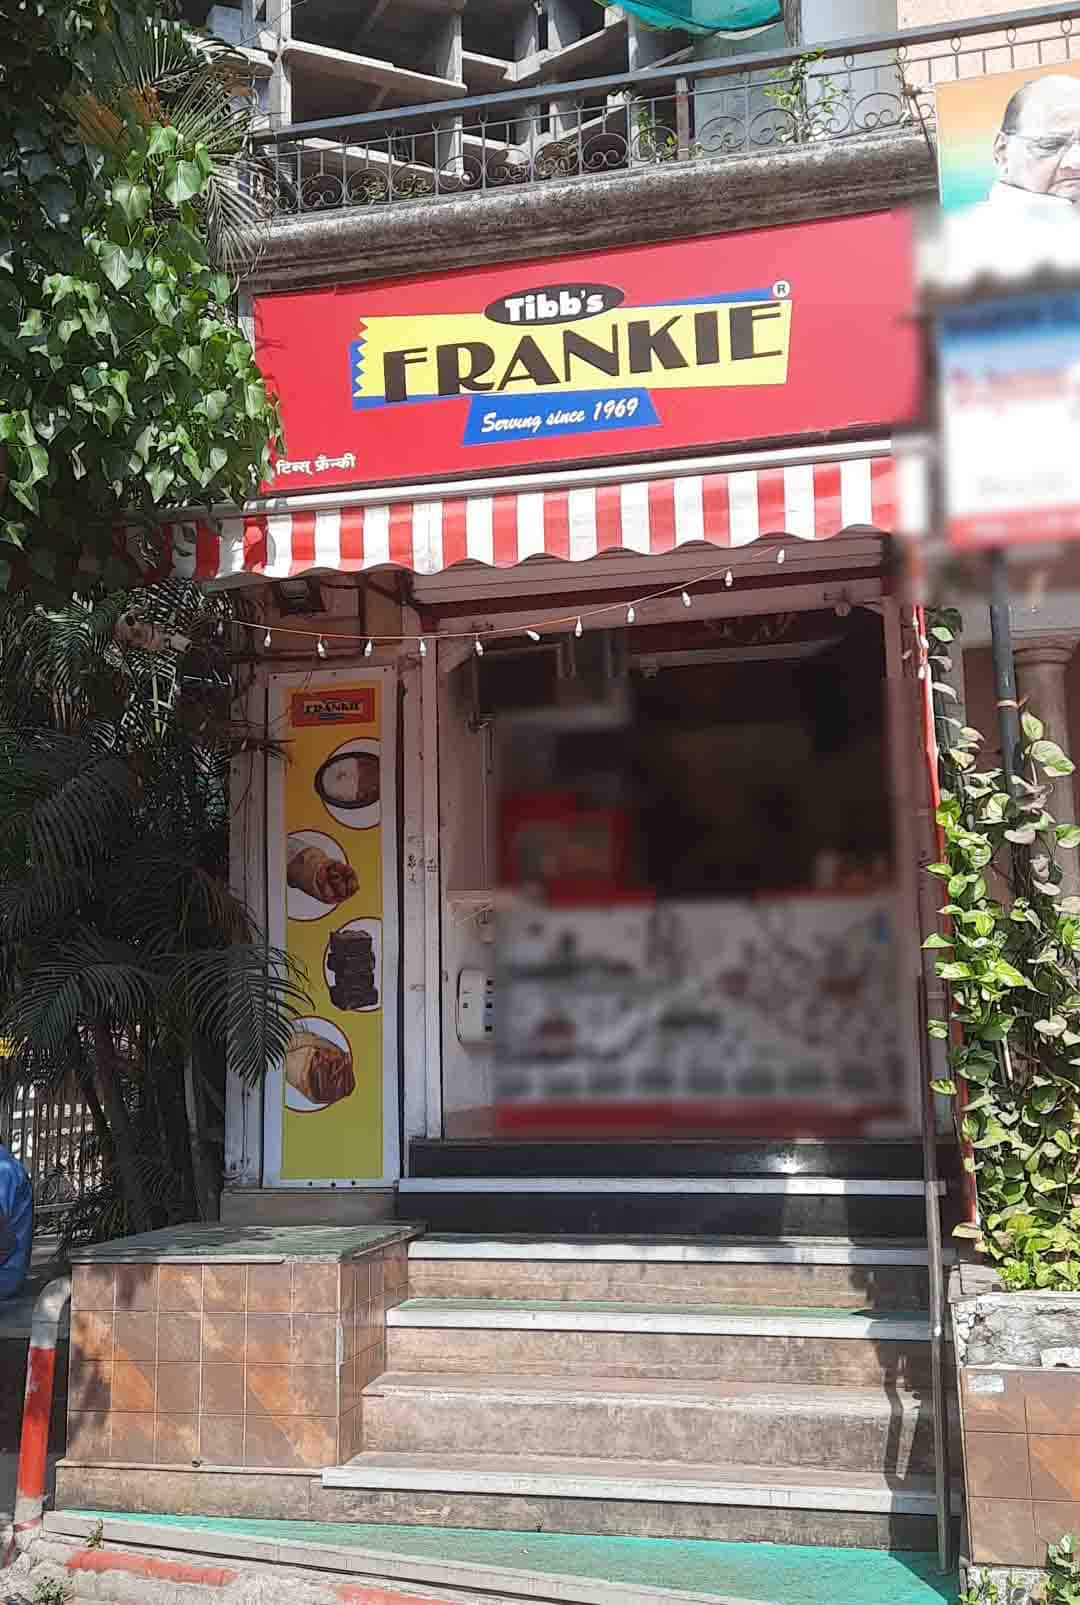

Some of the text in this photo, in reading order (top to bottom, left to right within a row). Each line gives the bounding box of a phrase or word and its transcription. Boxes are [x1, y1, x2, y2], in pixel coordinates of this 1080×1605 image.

[505, 289, 604, 322] Tibb's
[383, 302, 783, 403] FRANKIE
[481, 397, 639, 433] Serving since 1969
